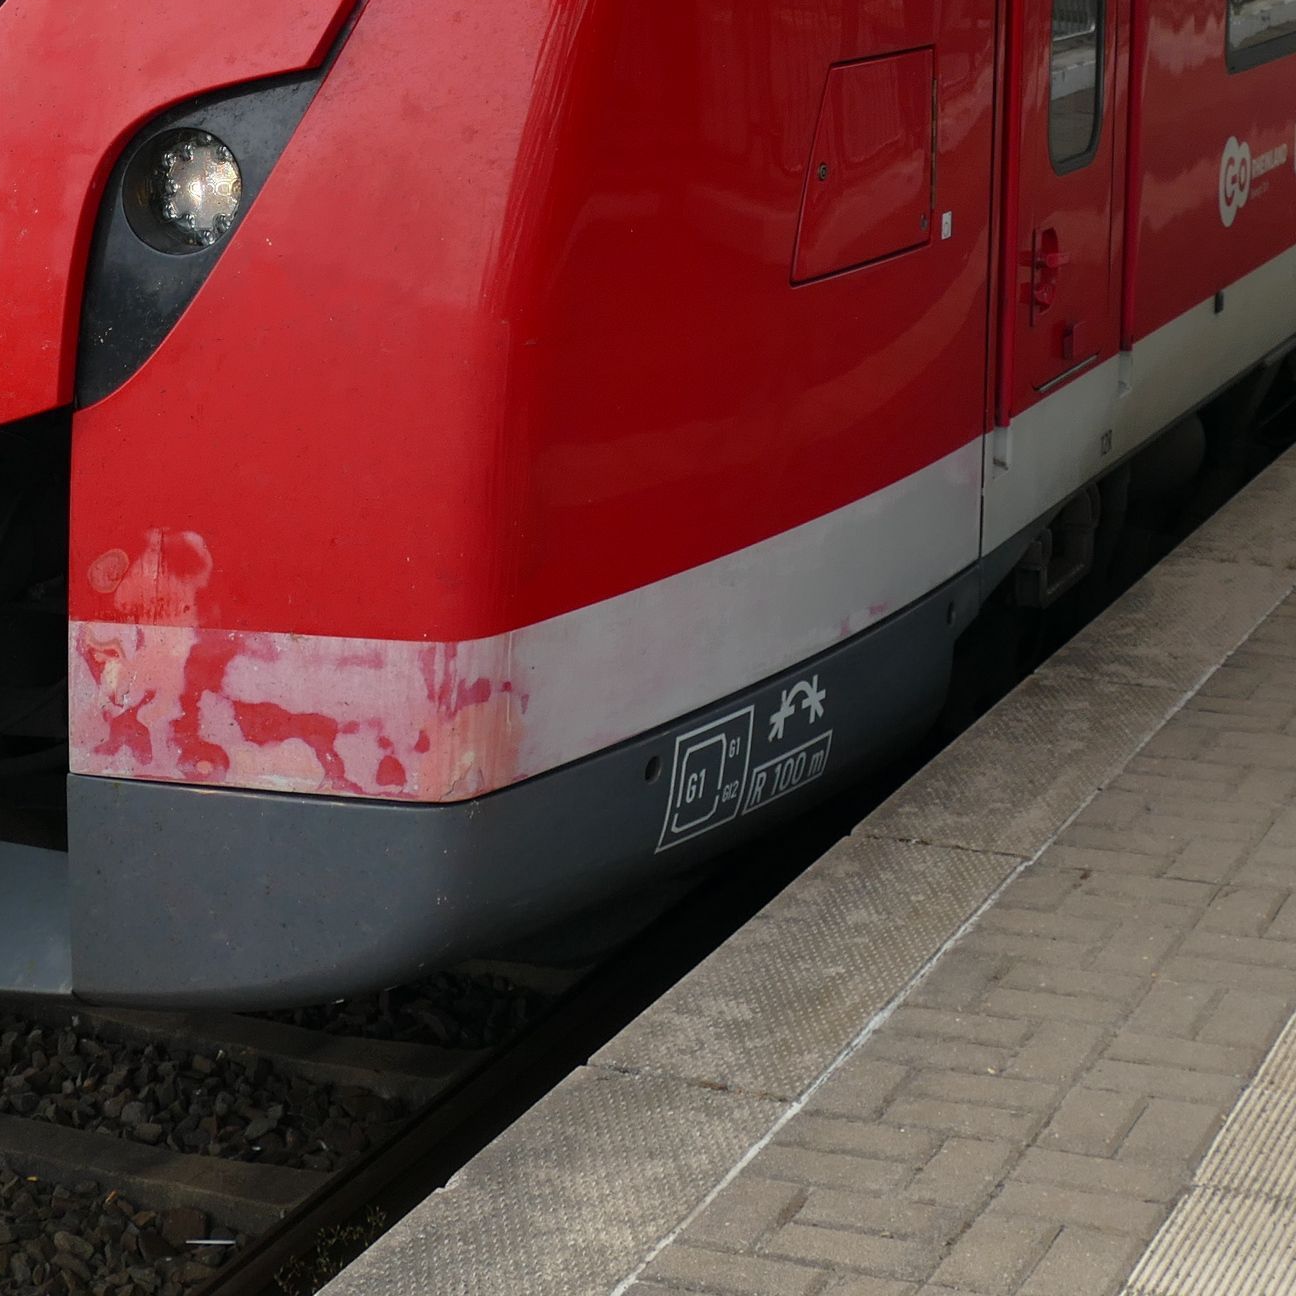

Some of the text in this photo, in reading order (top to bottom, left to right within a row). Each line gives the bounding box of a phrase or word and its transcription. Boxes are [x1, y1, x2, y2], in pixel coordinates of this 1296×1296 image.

[729, 738, 740, 758] G1
[686, 768, 706, 803] G1
[753, 750, 824, 804] R 100 m
